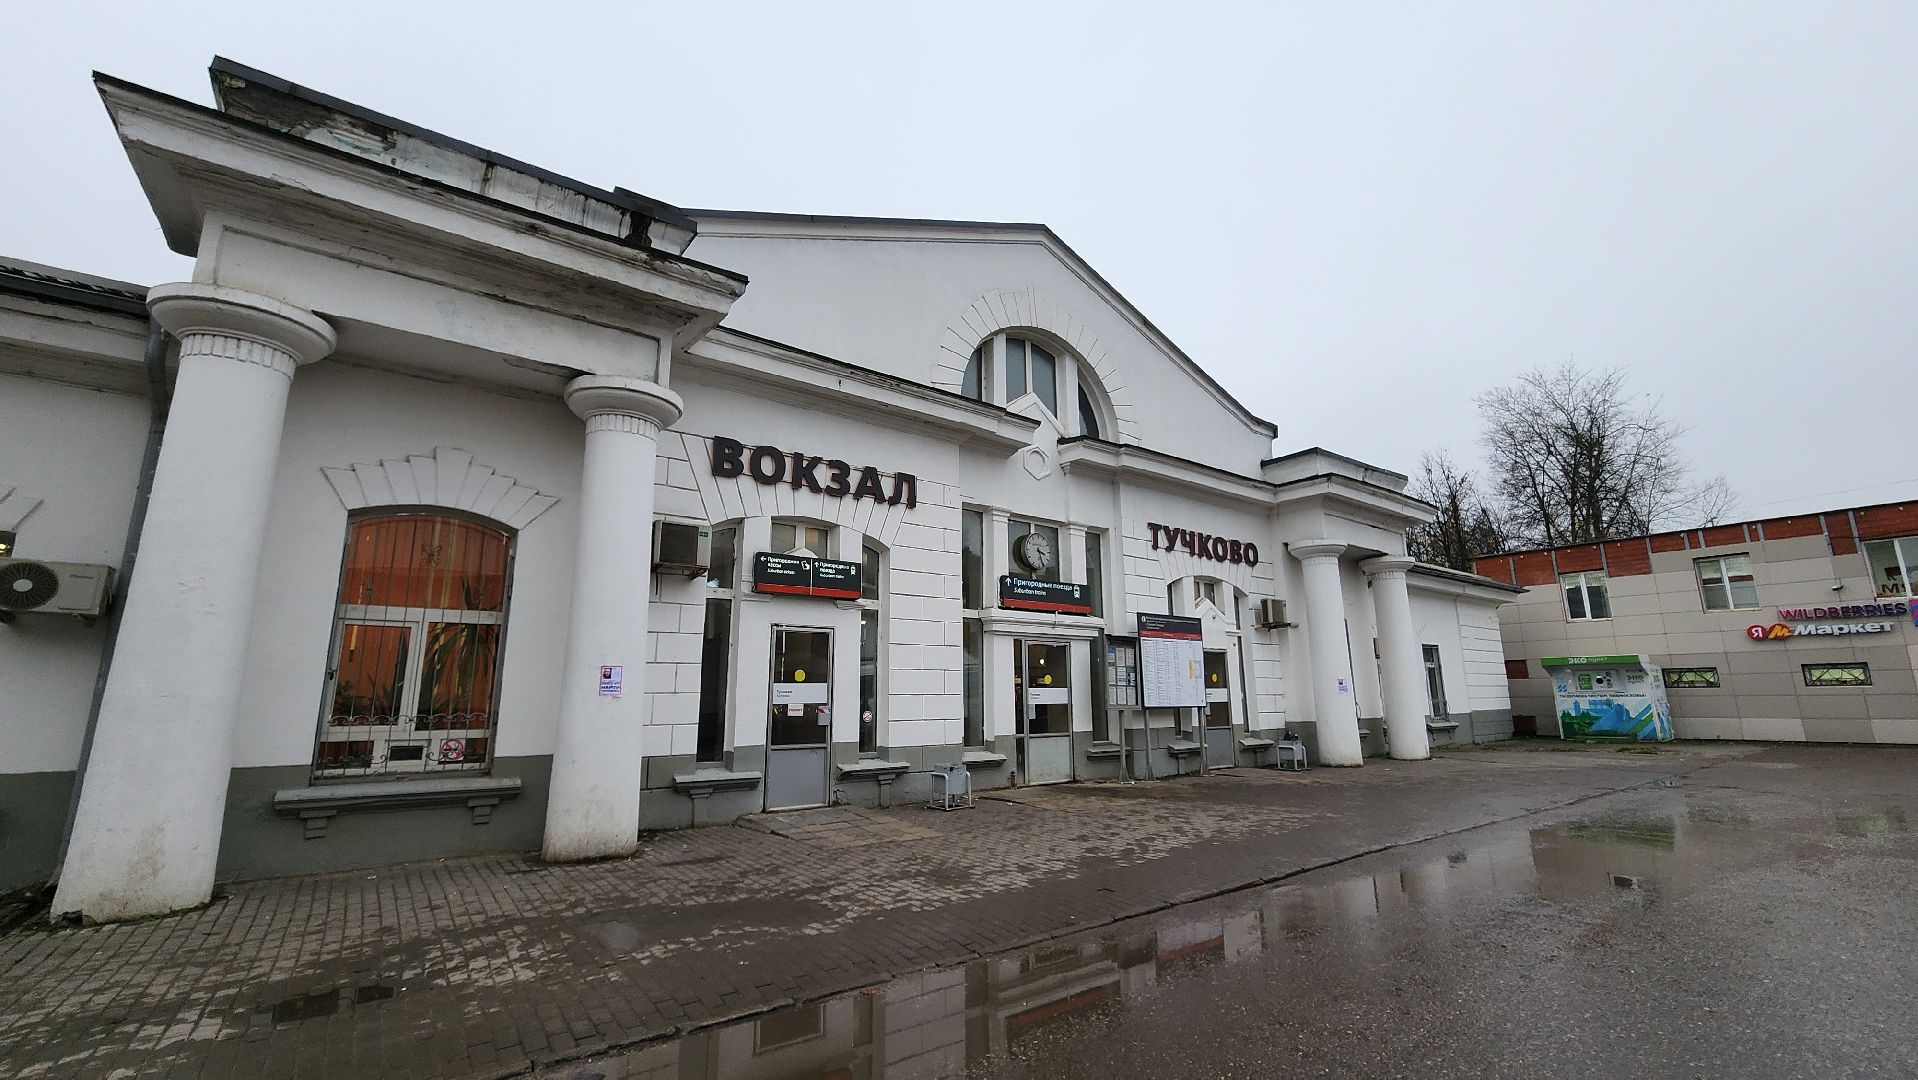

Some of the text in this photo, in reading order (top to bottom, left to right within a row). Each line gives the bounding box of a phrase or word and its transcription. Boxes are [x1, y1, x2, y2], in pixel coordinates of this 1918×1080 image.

[713, 435, 917, 509] ВОКЗАЛ
[1147, 522, 1259, 567] ТУЧКОВО
[1013, 577, 1073, 592] Пригородные поезда
[1013, 587, 1034, 595] Suburban
[1778, 602, 1908, 621] WILDBERRIES
